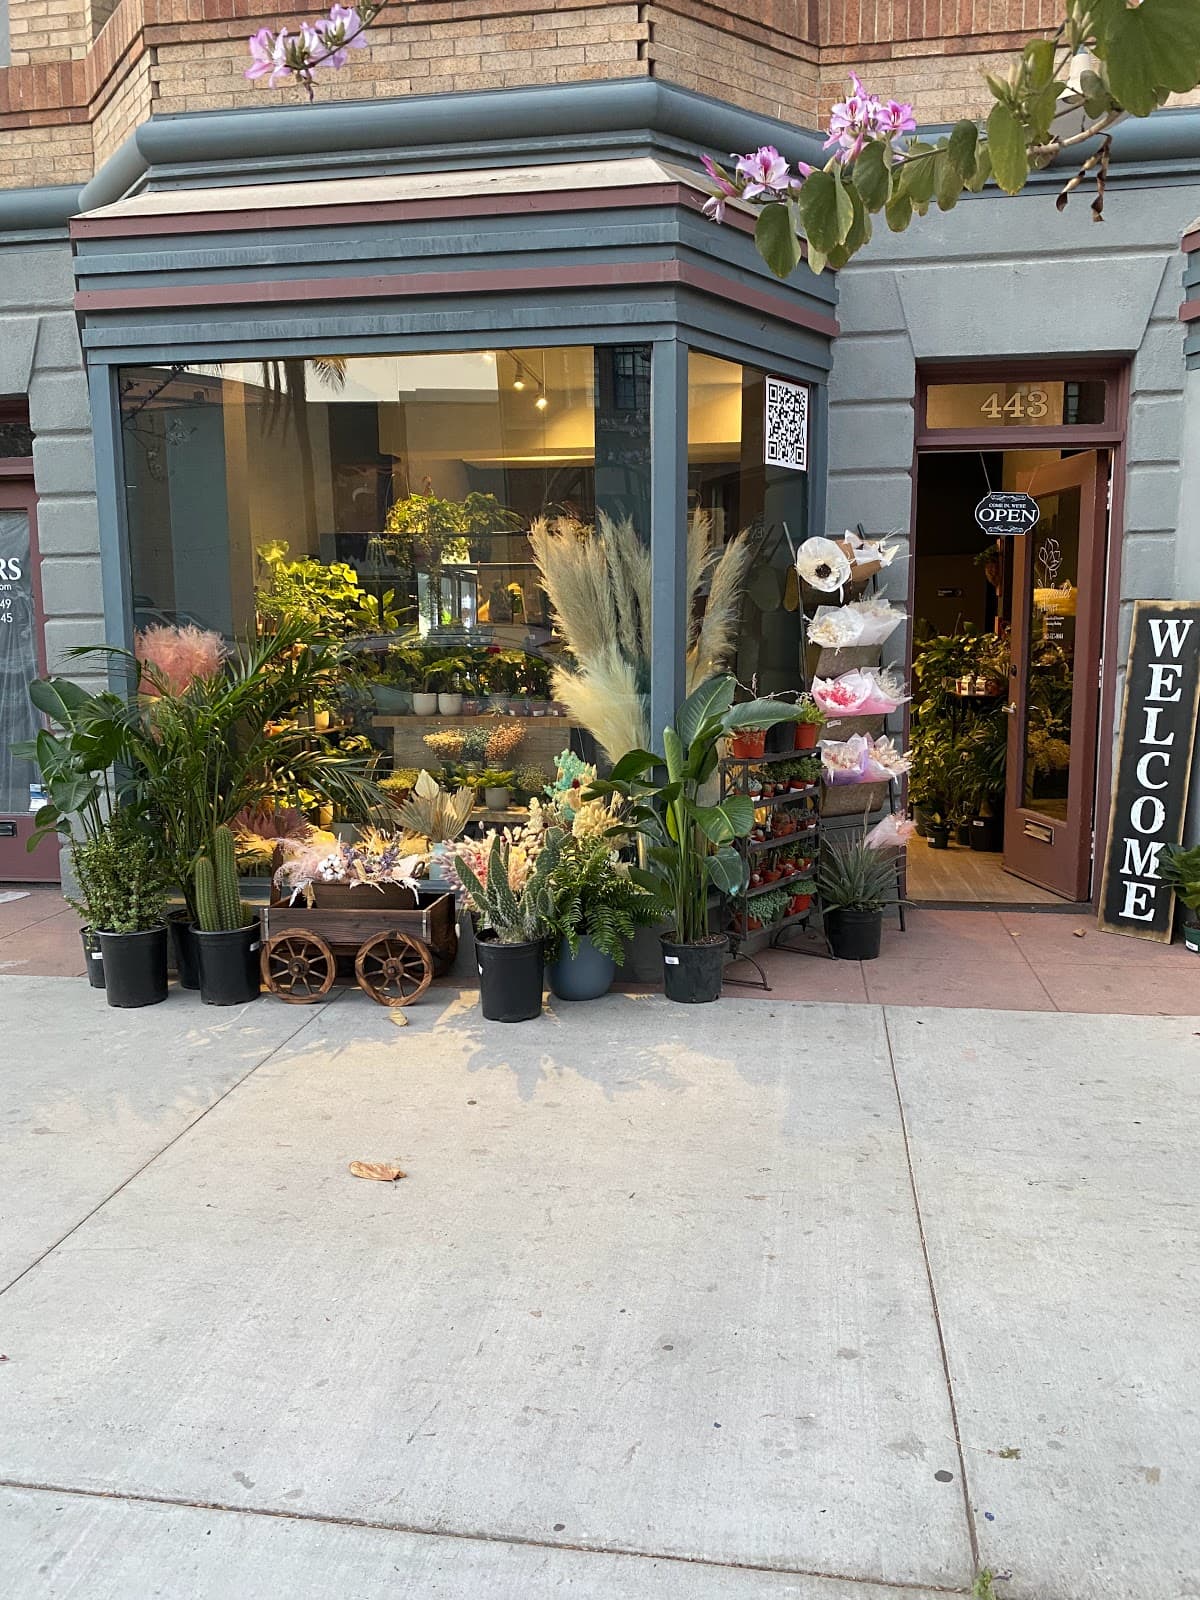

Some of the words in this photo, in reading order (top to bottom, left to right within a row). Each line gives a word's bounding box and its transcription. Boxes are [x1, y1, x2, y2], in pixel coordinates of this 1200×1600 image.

[980, 390, 1048, 418] 443
[979, 508, 1037, 522] OPEN
[1119, 619, 1194, 922] WELCOME
